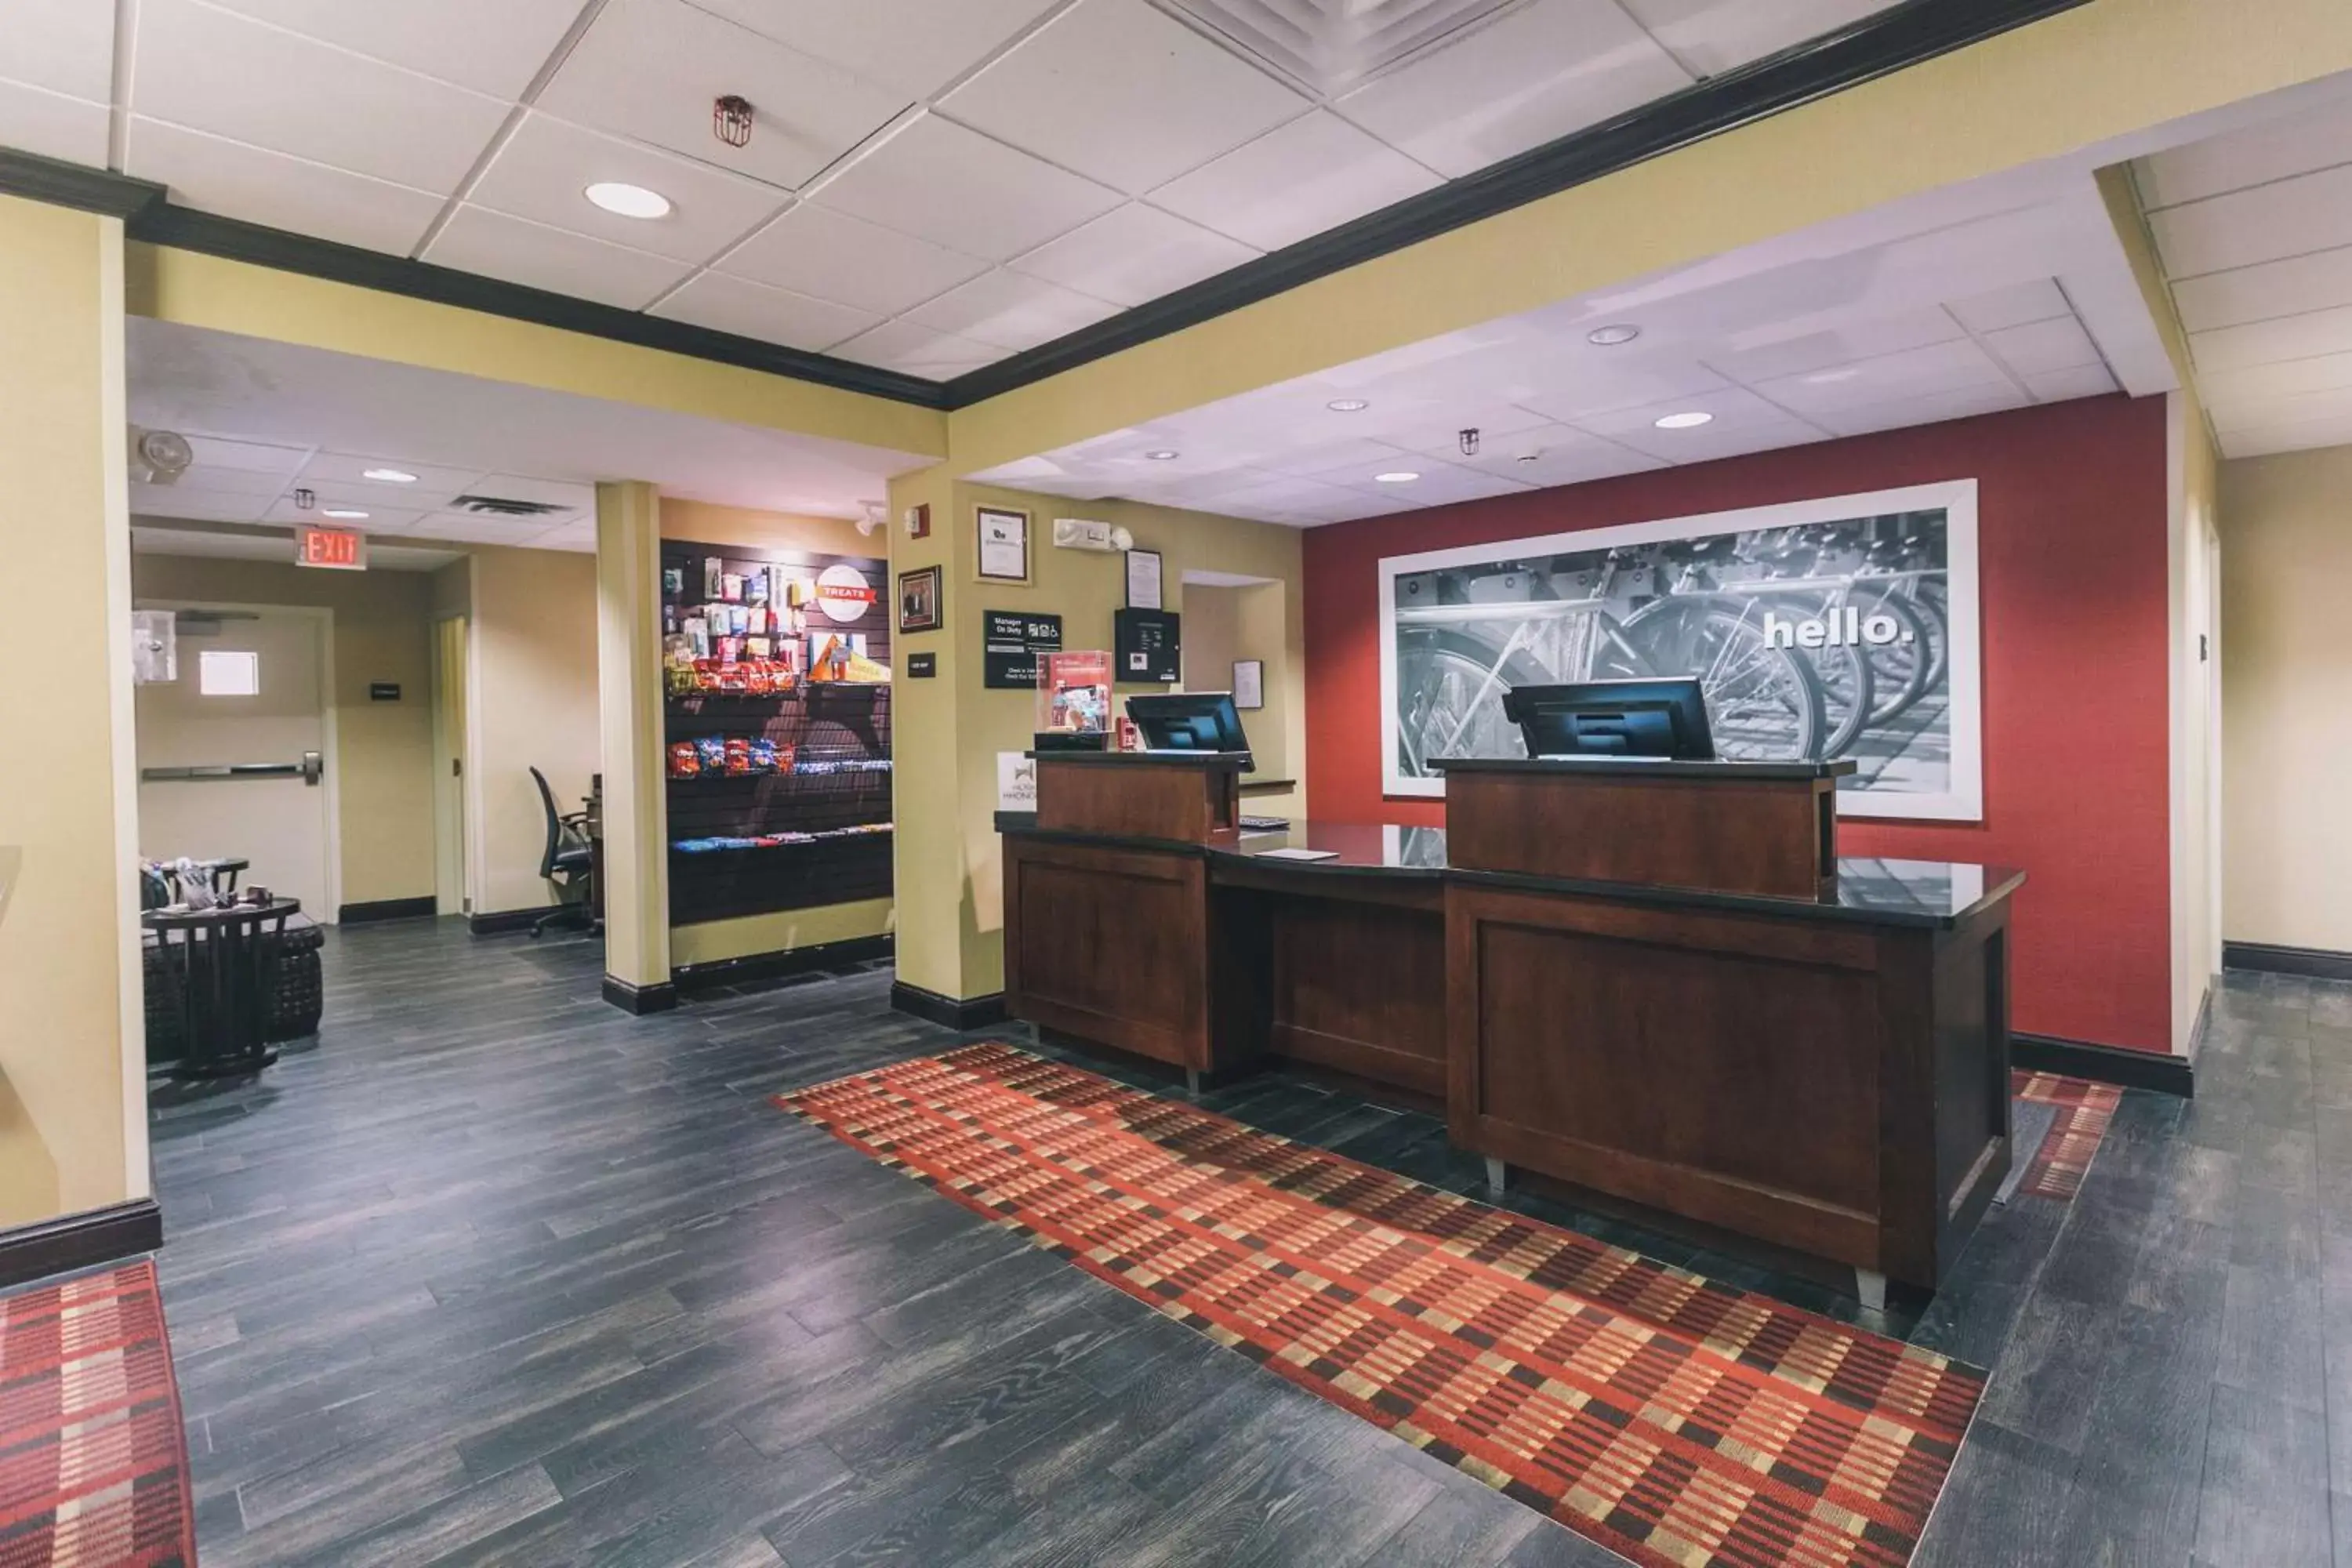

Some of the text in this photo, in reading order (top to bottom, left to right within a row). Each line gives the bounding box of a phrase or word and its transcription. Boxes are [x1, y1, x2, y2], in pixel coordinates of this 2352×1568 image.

[307, 532, 356, 563] EXIT
[825, 587, 865, 598] TREATS
[995, 617, 1022, 626] Manager
[1764, 606, 1915, 649] hello.
